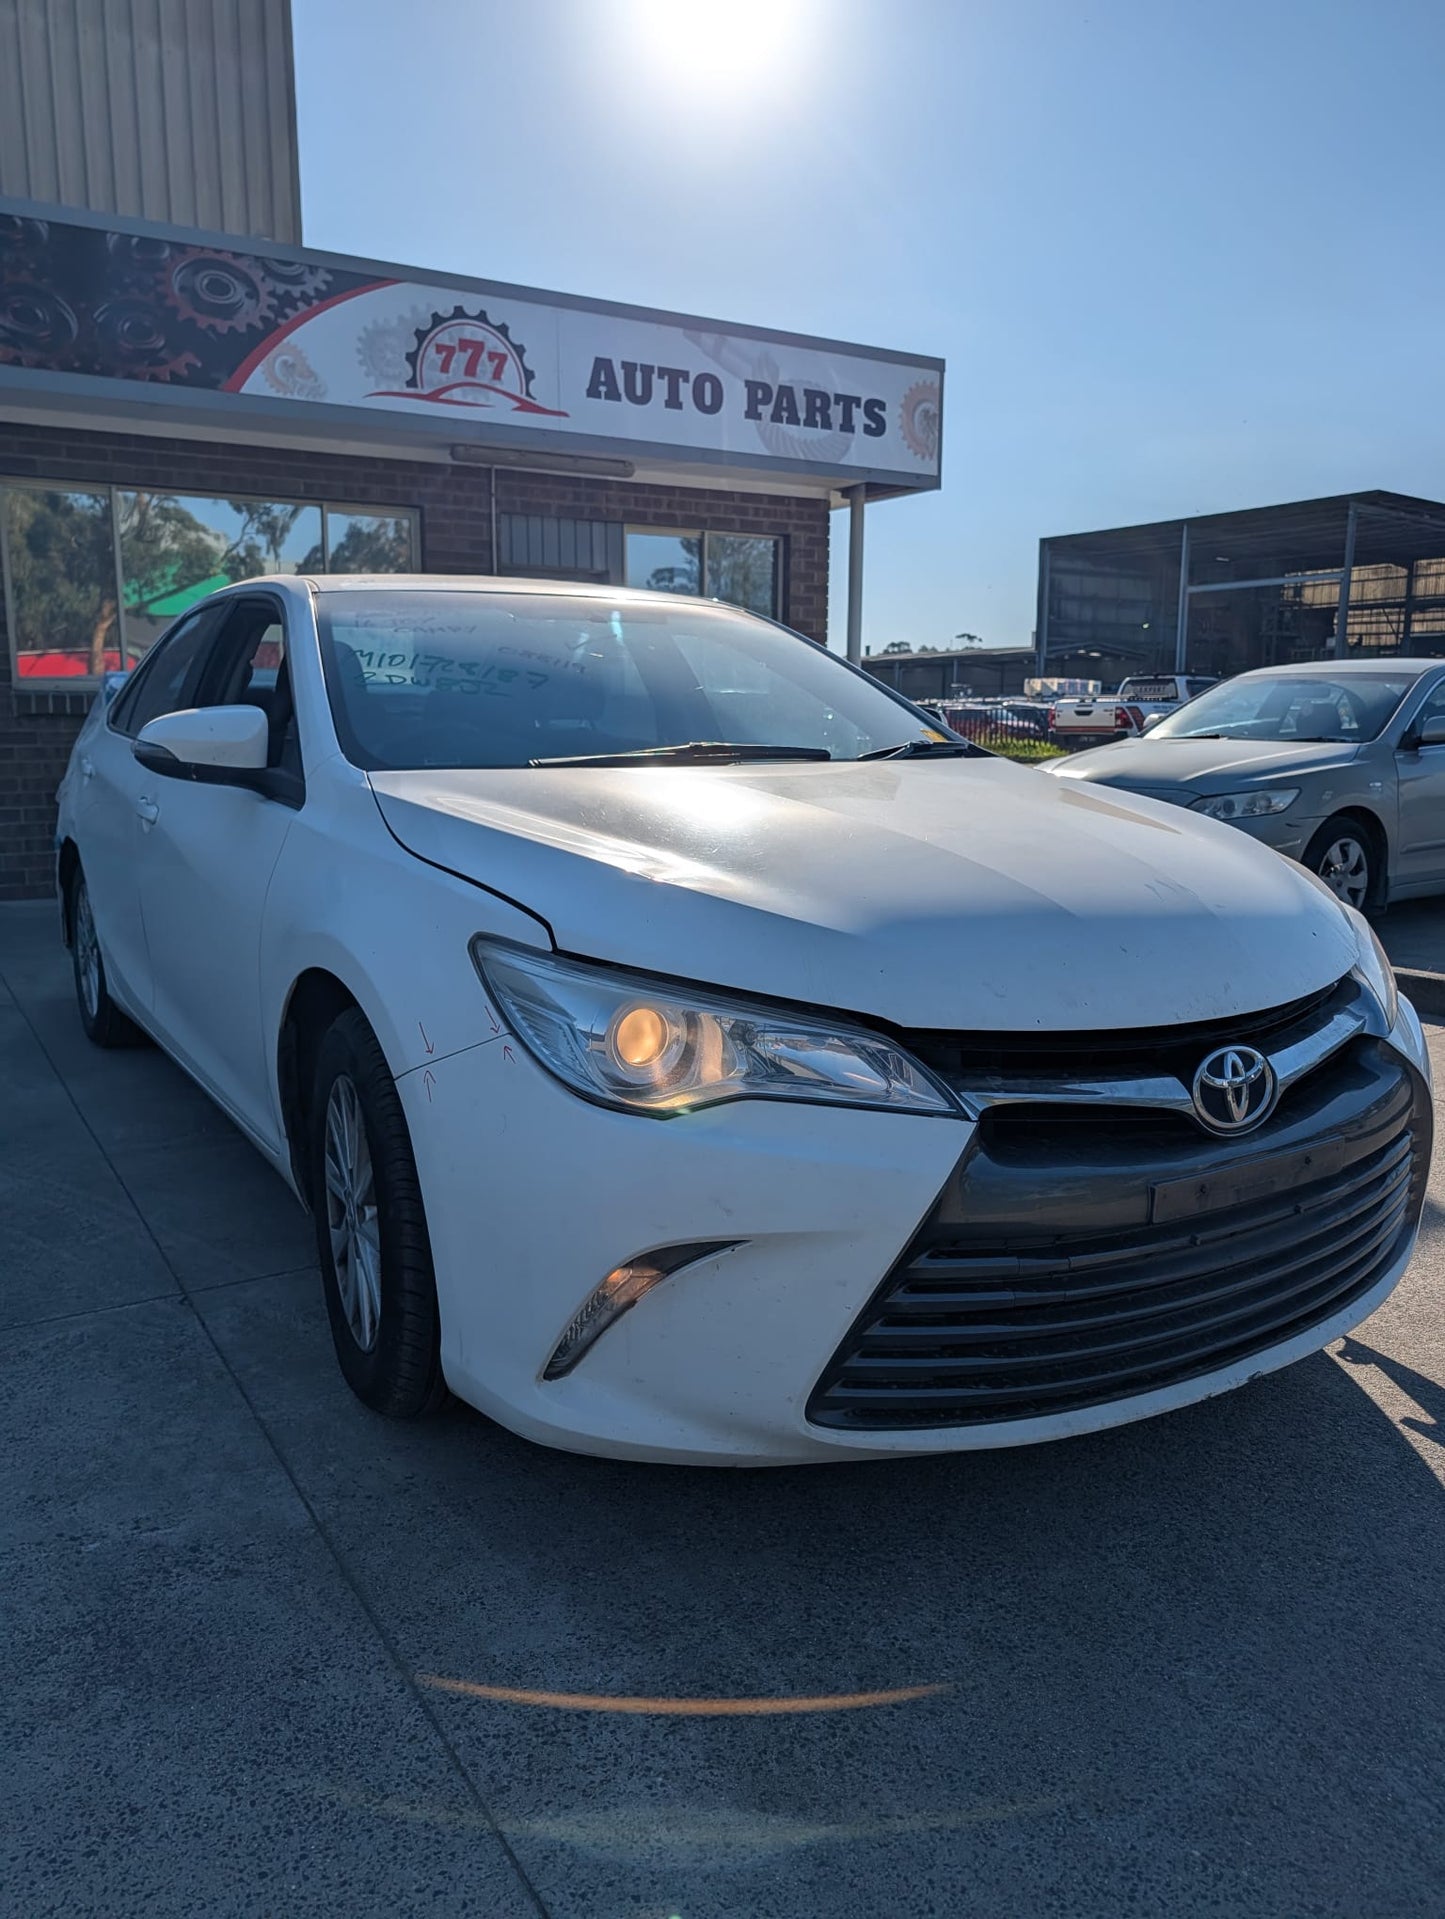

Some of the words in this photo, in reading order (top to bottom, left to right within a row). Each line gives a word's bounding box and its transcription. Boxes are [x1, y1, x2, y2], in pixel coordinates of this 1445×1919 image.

[434, 338, 509, 382] 777
[586, 356, 724, 416] AUTO
[744, 379, 888, 438] PARTS
